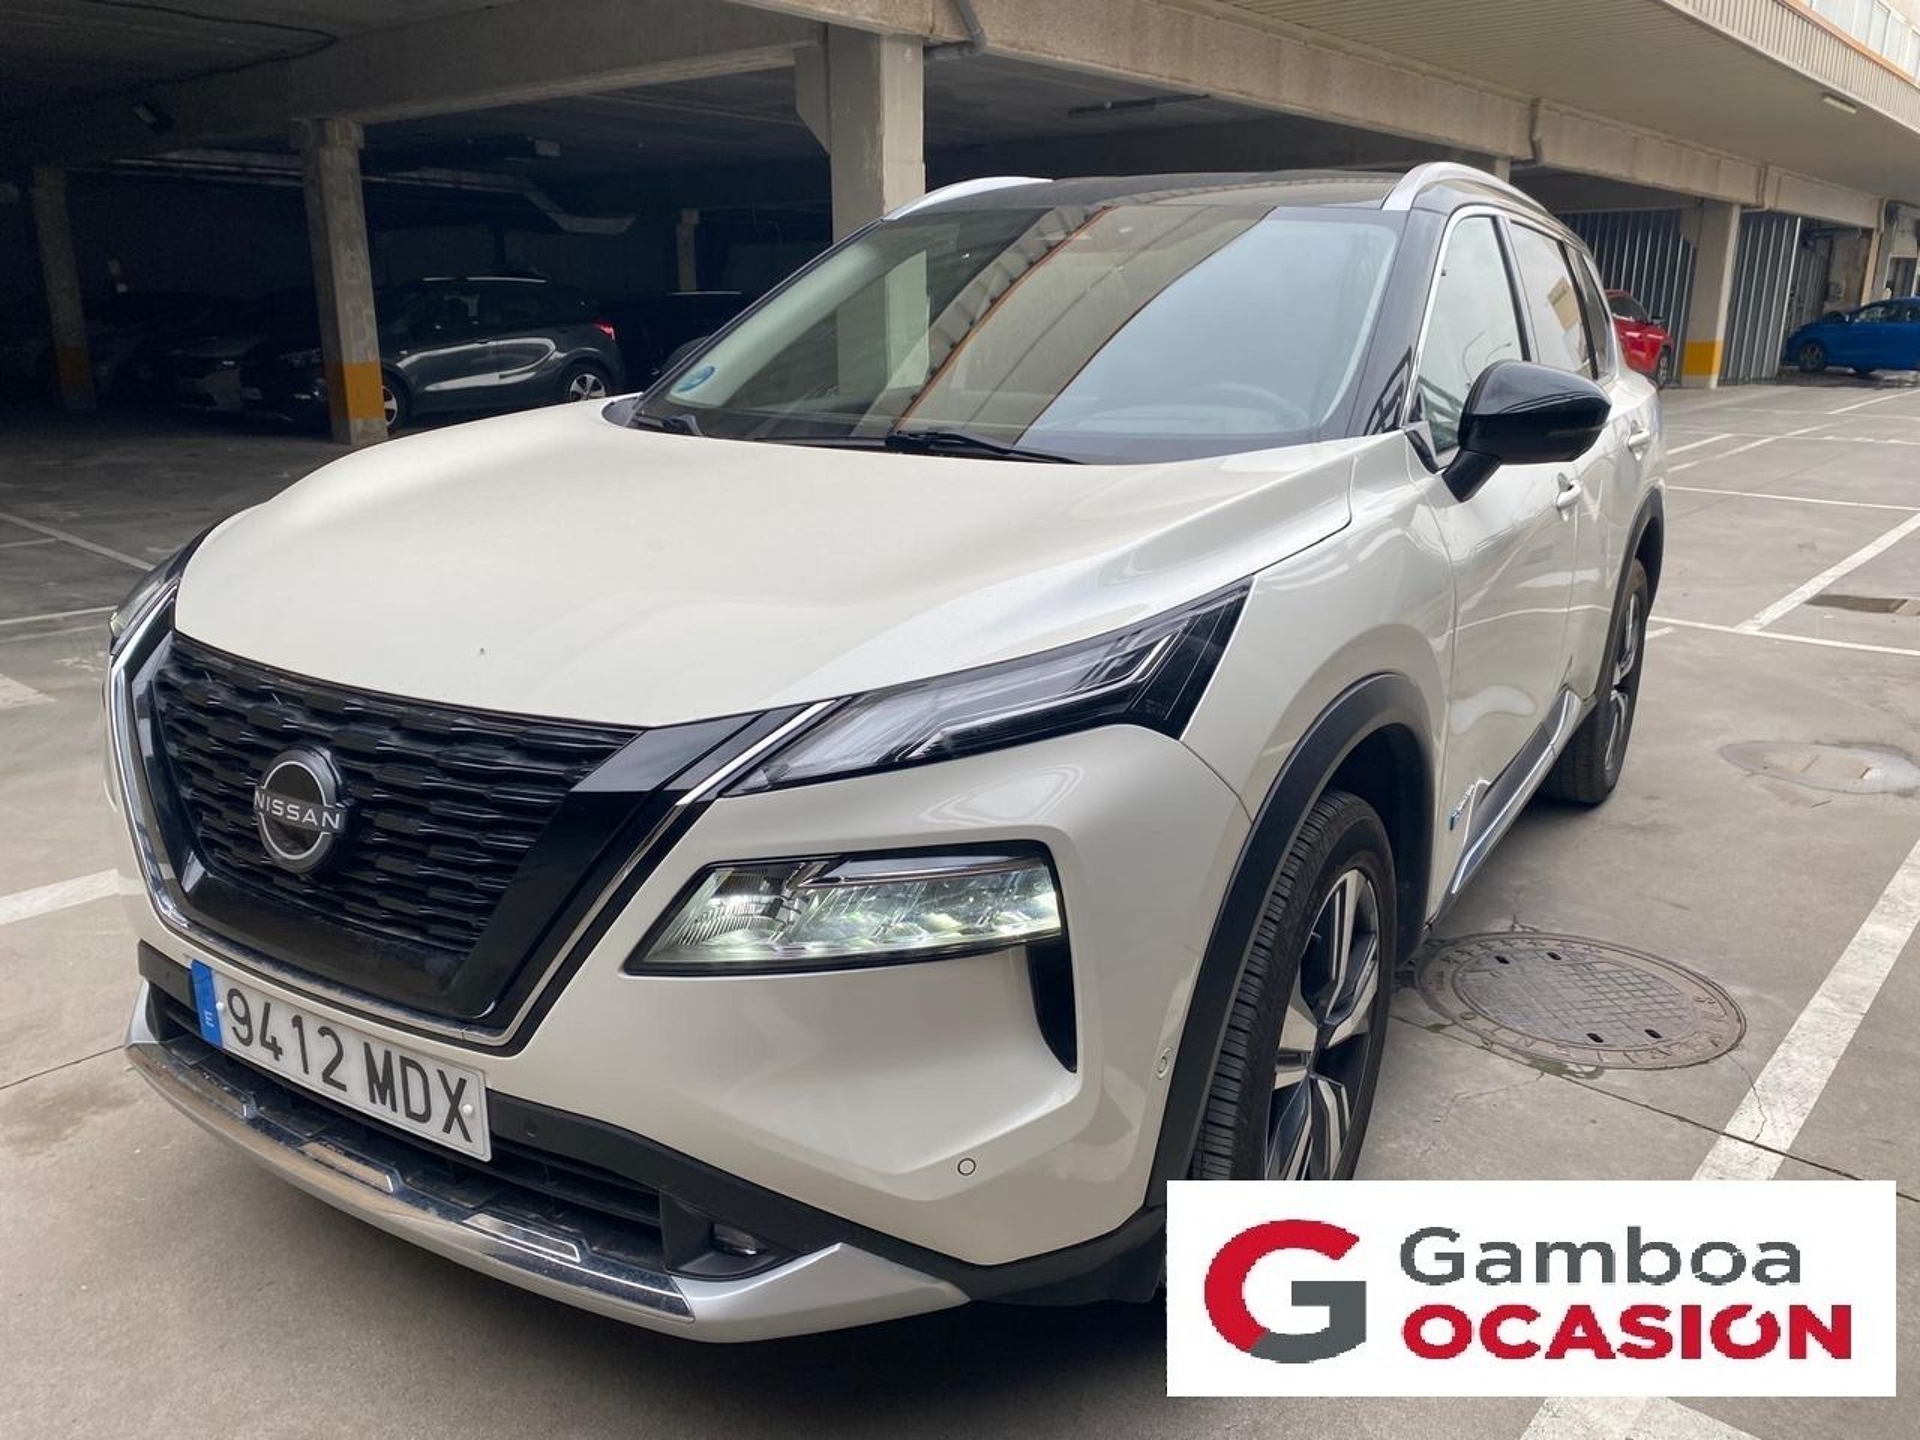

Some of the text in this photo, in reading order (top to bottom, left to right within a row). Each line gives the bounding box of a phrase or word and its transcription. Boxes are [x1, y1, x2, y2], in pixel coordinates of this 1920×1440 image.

[254, 789, 340, 829] NISSAN
[204, 1009, 214, 1028] E
[227, 987, 473, 1143] 9412 MDX
